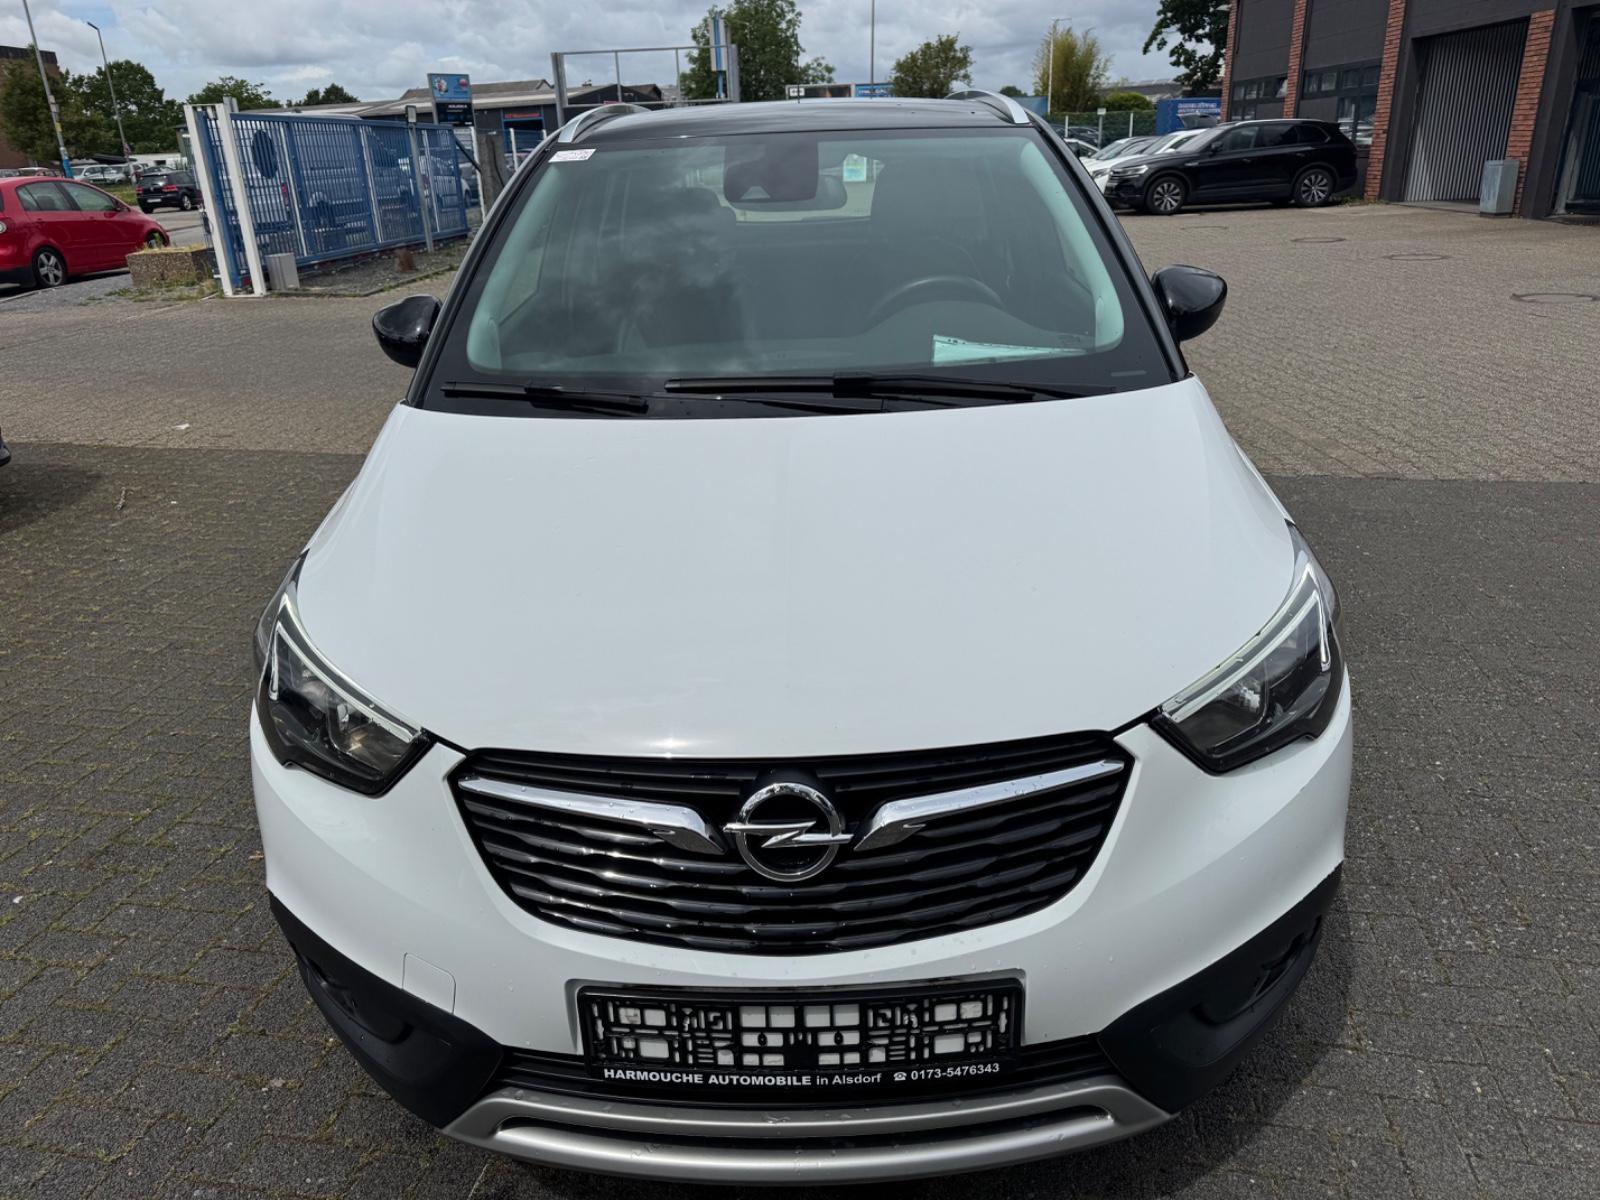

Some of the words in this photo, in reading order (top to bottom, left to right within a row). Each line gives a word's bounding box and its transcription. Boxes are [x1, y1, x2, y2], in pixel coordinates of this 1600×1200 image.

[603, 1068, 704, 1084] HARMOUCHE
[708, 1074, 812, 1086] AUTOMOBILE
[816, 1075, 829, 1086] in
[831, 1073, 882, 1086] Alsdorf
[910, 1062, 1000, 1081] 0173-5476343
